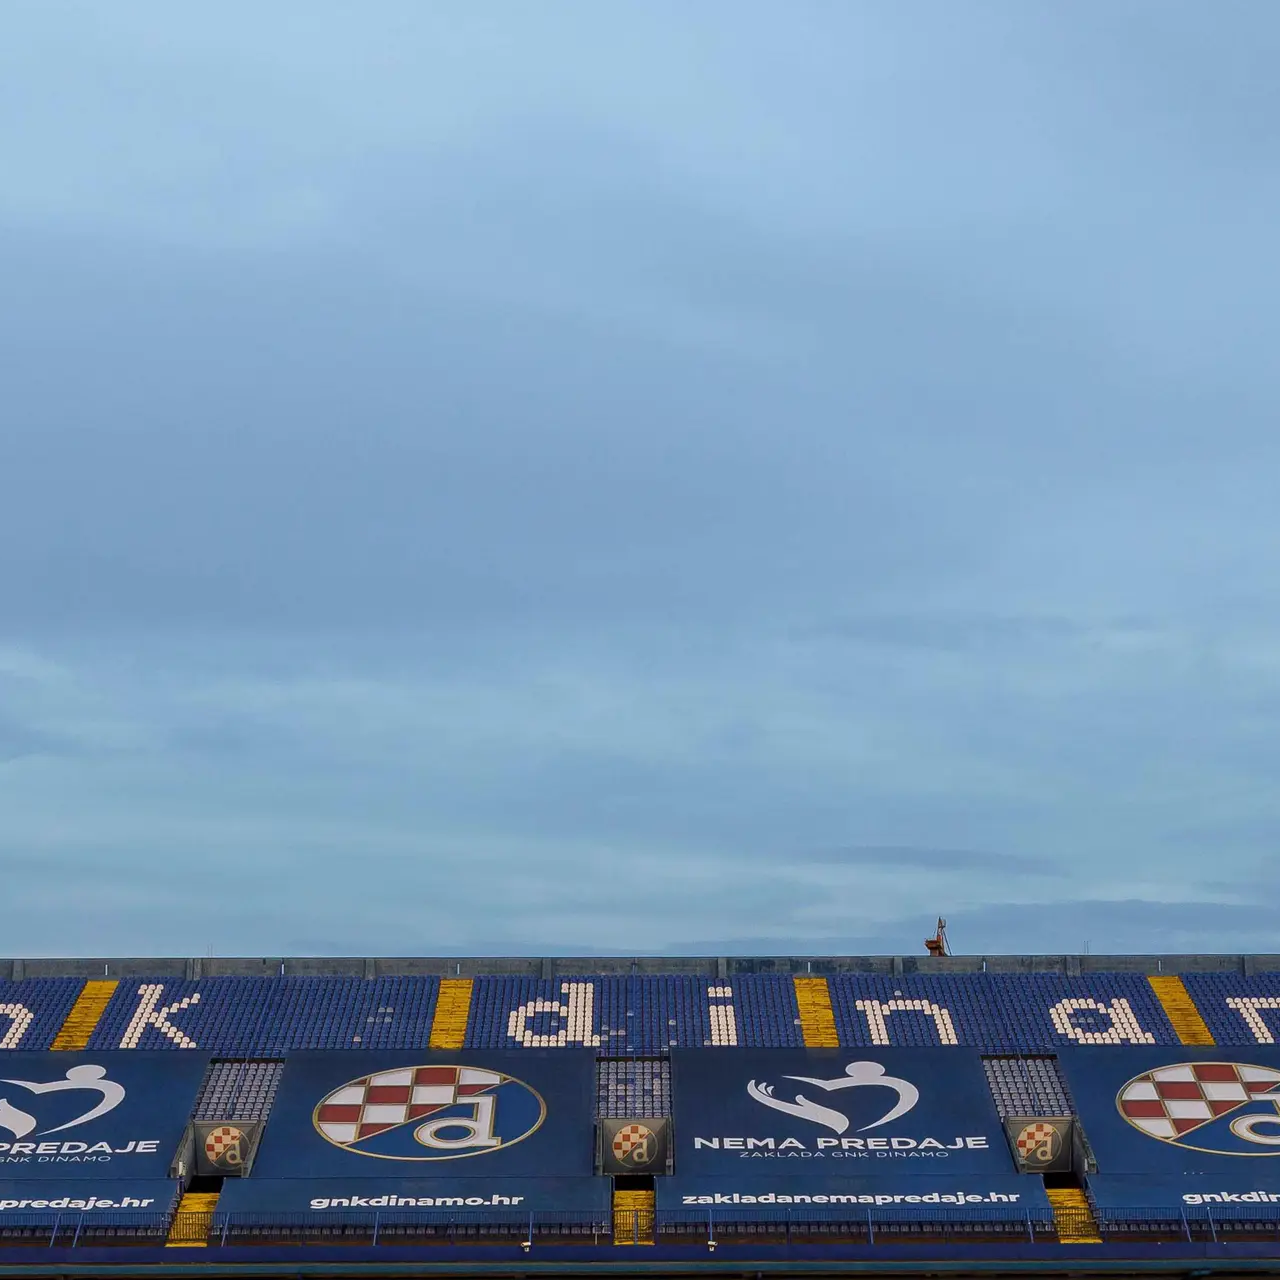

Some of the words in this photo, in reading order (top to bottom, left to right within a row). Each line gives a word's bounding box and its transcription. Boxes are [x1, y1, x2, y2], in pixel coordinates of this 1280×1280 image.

[695, 1137, 805, 1150] NEMA
[816, 1136, 989, 1150] PREDAJE
[311, 1195, 523, 1208] gnkdinamo.hr
[683, 1192, 1019, 1205] zakladanemapredaje.hr
